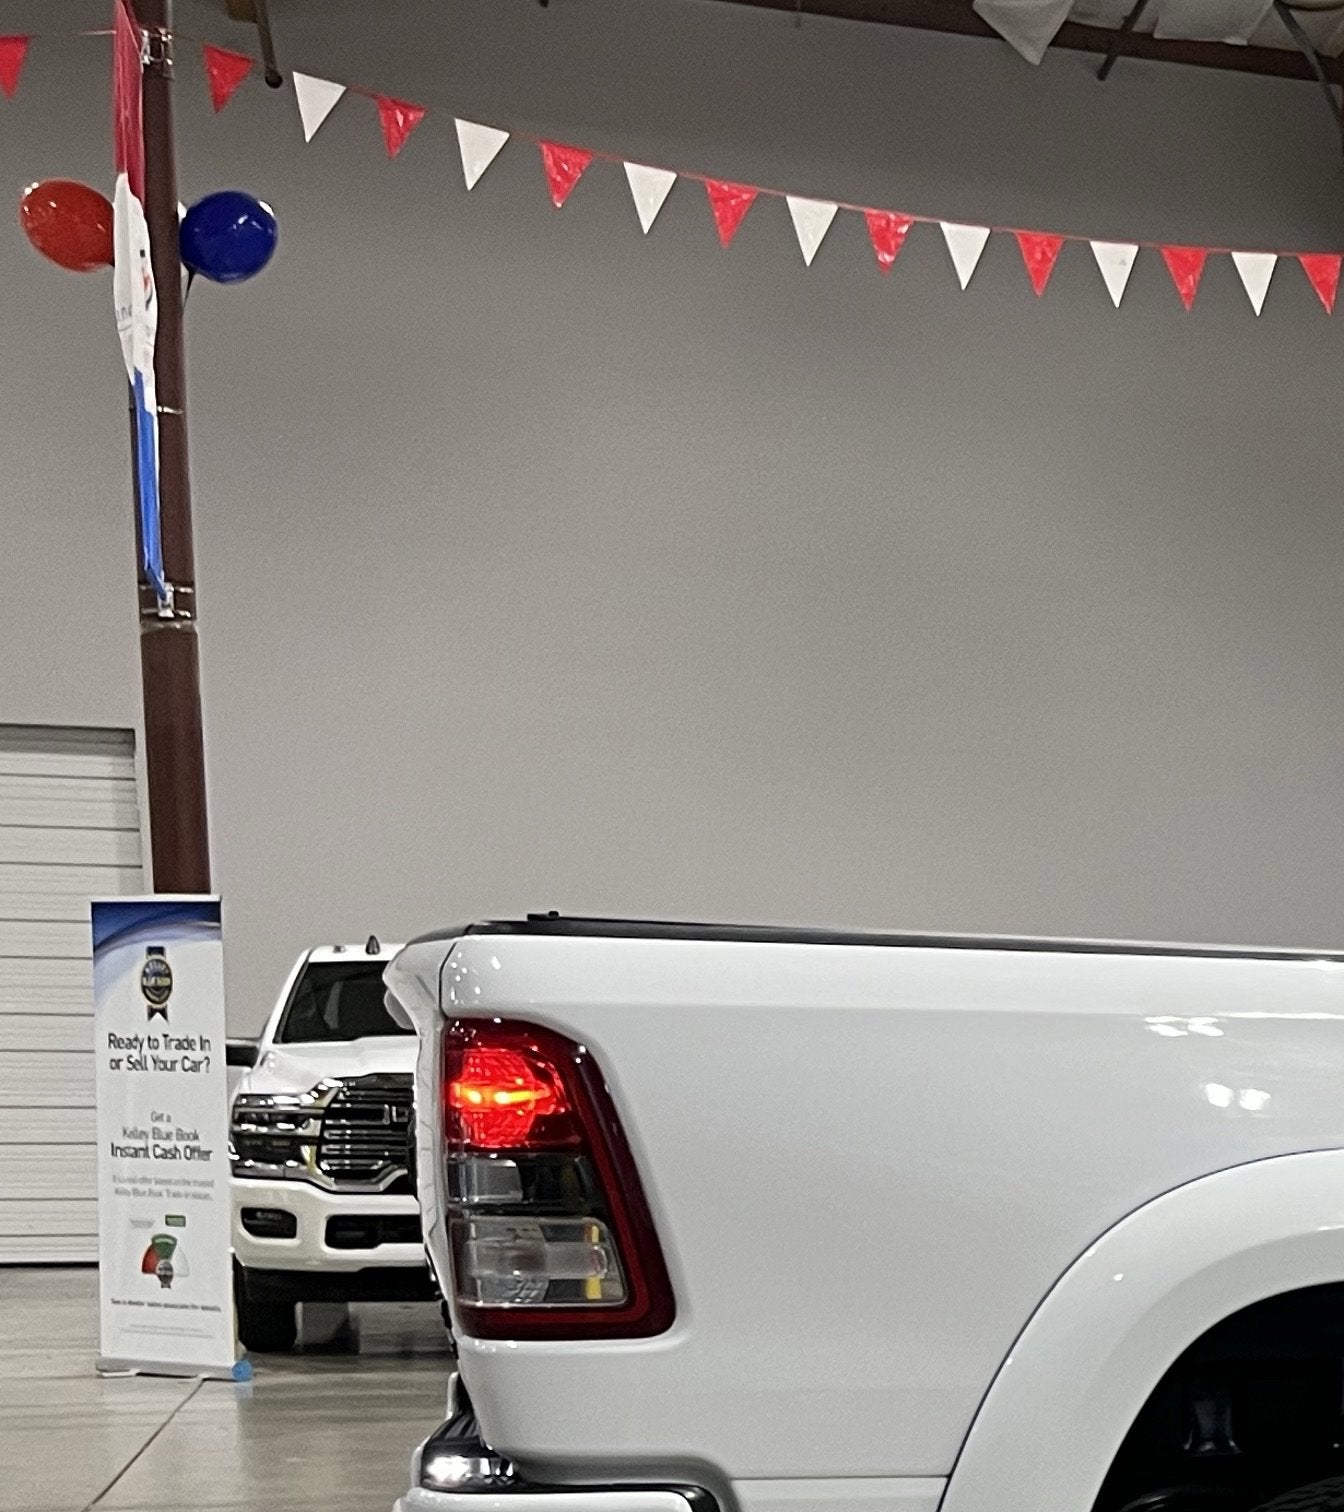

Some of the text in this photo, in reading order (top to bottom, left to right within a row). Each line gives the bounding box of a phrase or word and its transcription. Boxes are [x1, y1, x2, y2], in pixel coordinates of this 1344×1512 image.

[108, 1032, 211, 1054] Ready to Trade In
[109, 1054, 210, 1073] or Sell Your Car?
[152, 1126, 173, 1140] Blue
[176, 1128, 199, 1141] Book
[111, 1141, 213, 1161] Instant Cash Offer
